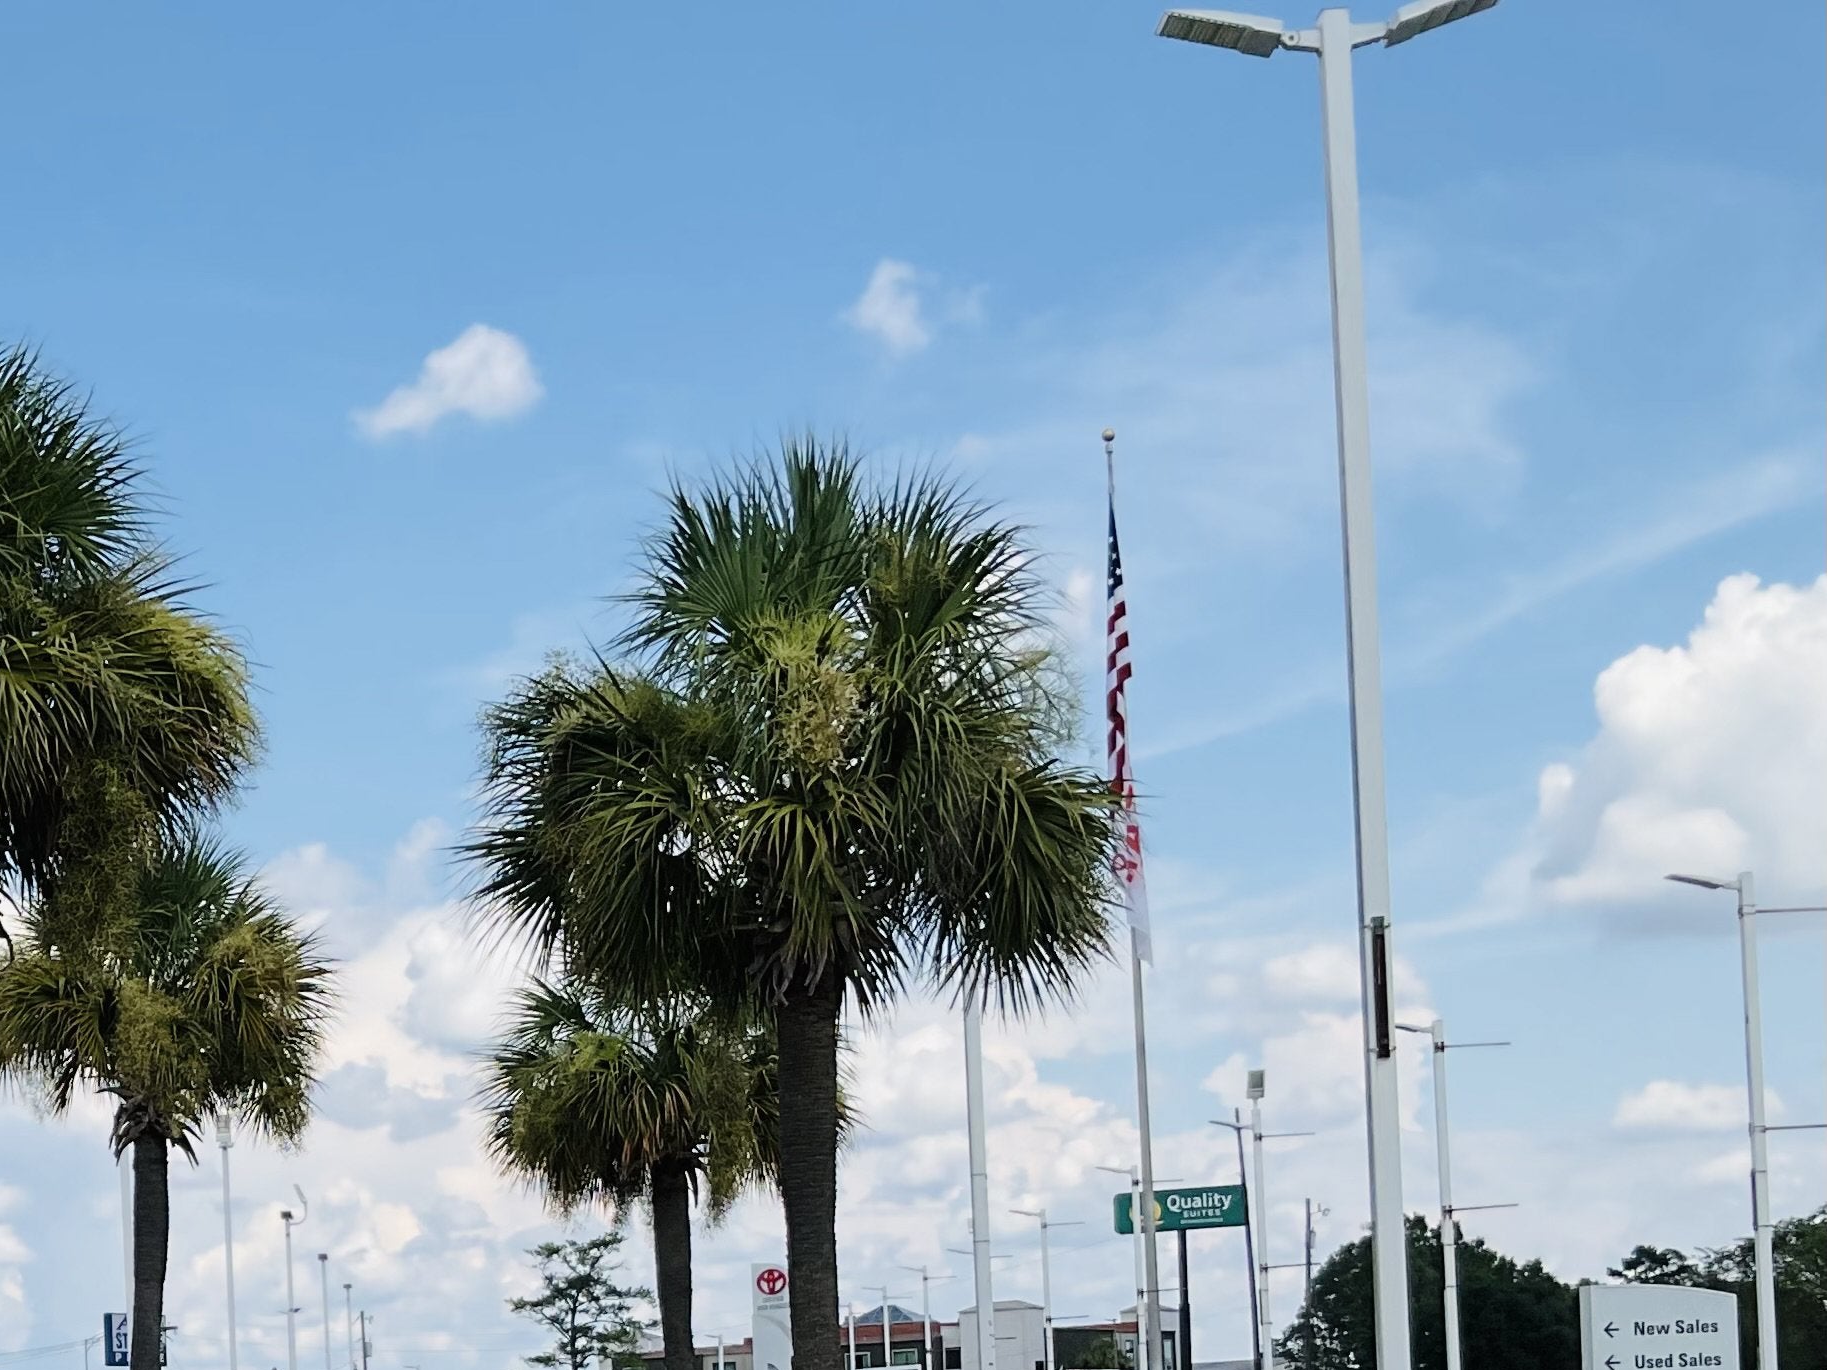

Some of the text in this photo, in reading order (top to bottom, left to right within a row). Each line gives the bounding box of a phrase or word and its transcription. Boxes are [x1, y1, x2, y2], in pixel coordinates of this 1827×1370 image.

[1166, 1192, 1232, 1213] Quality
[1183, 1208, 1222, 1218] SUITES
[1633, 1318, 1719, 1336] New Sales
[1634, 1352, 1723, 1369] Used Sales
